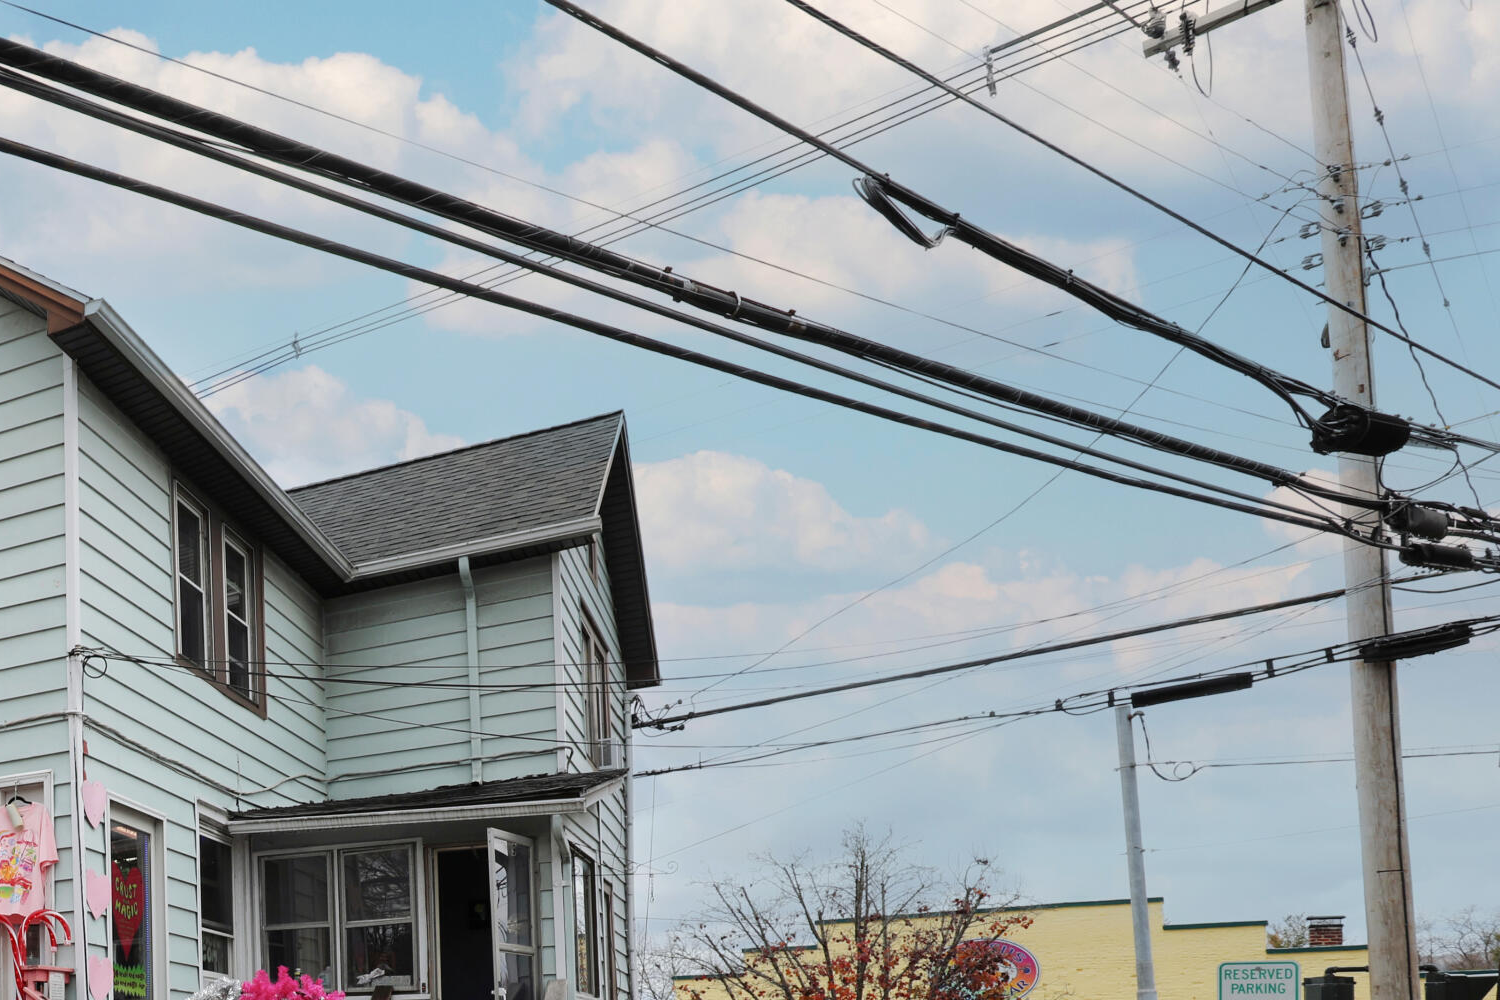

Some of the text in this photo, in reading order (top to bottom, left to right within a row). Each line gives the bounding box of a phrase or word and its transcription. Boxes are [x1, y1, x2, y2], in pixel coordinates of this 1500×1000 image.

[115, 876, 137, 899] CRUST
[115, 899, 138, 920] MAGIC
[1224, 968, 1293, 980] RESERVED
[1231, 983, 1286, 995] PARKING
